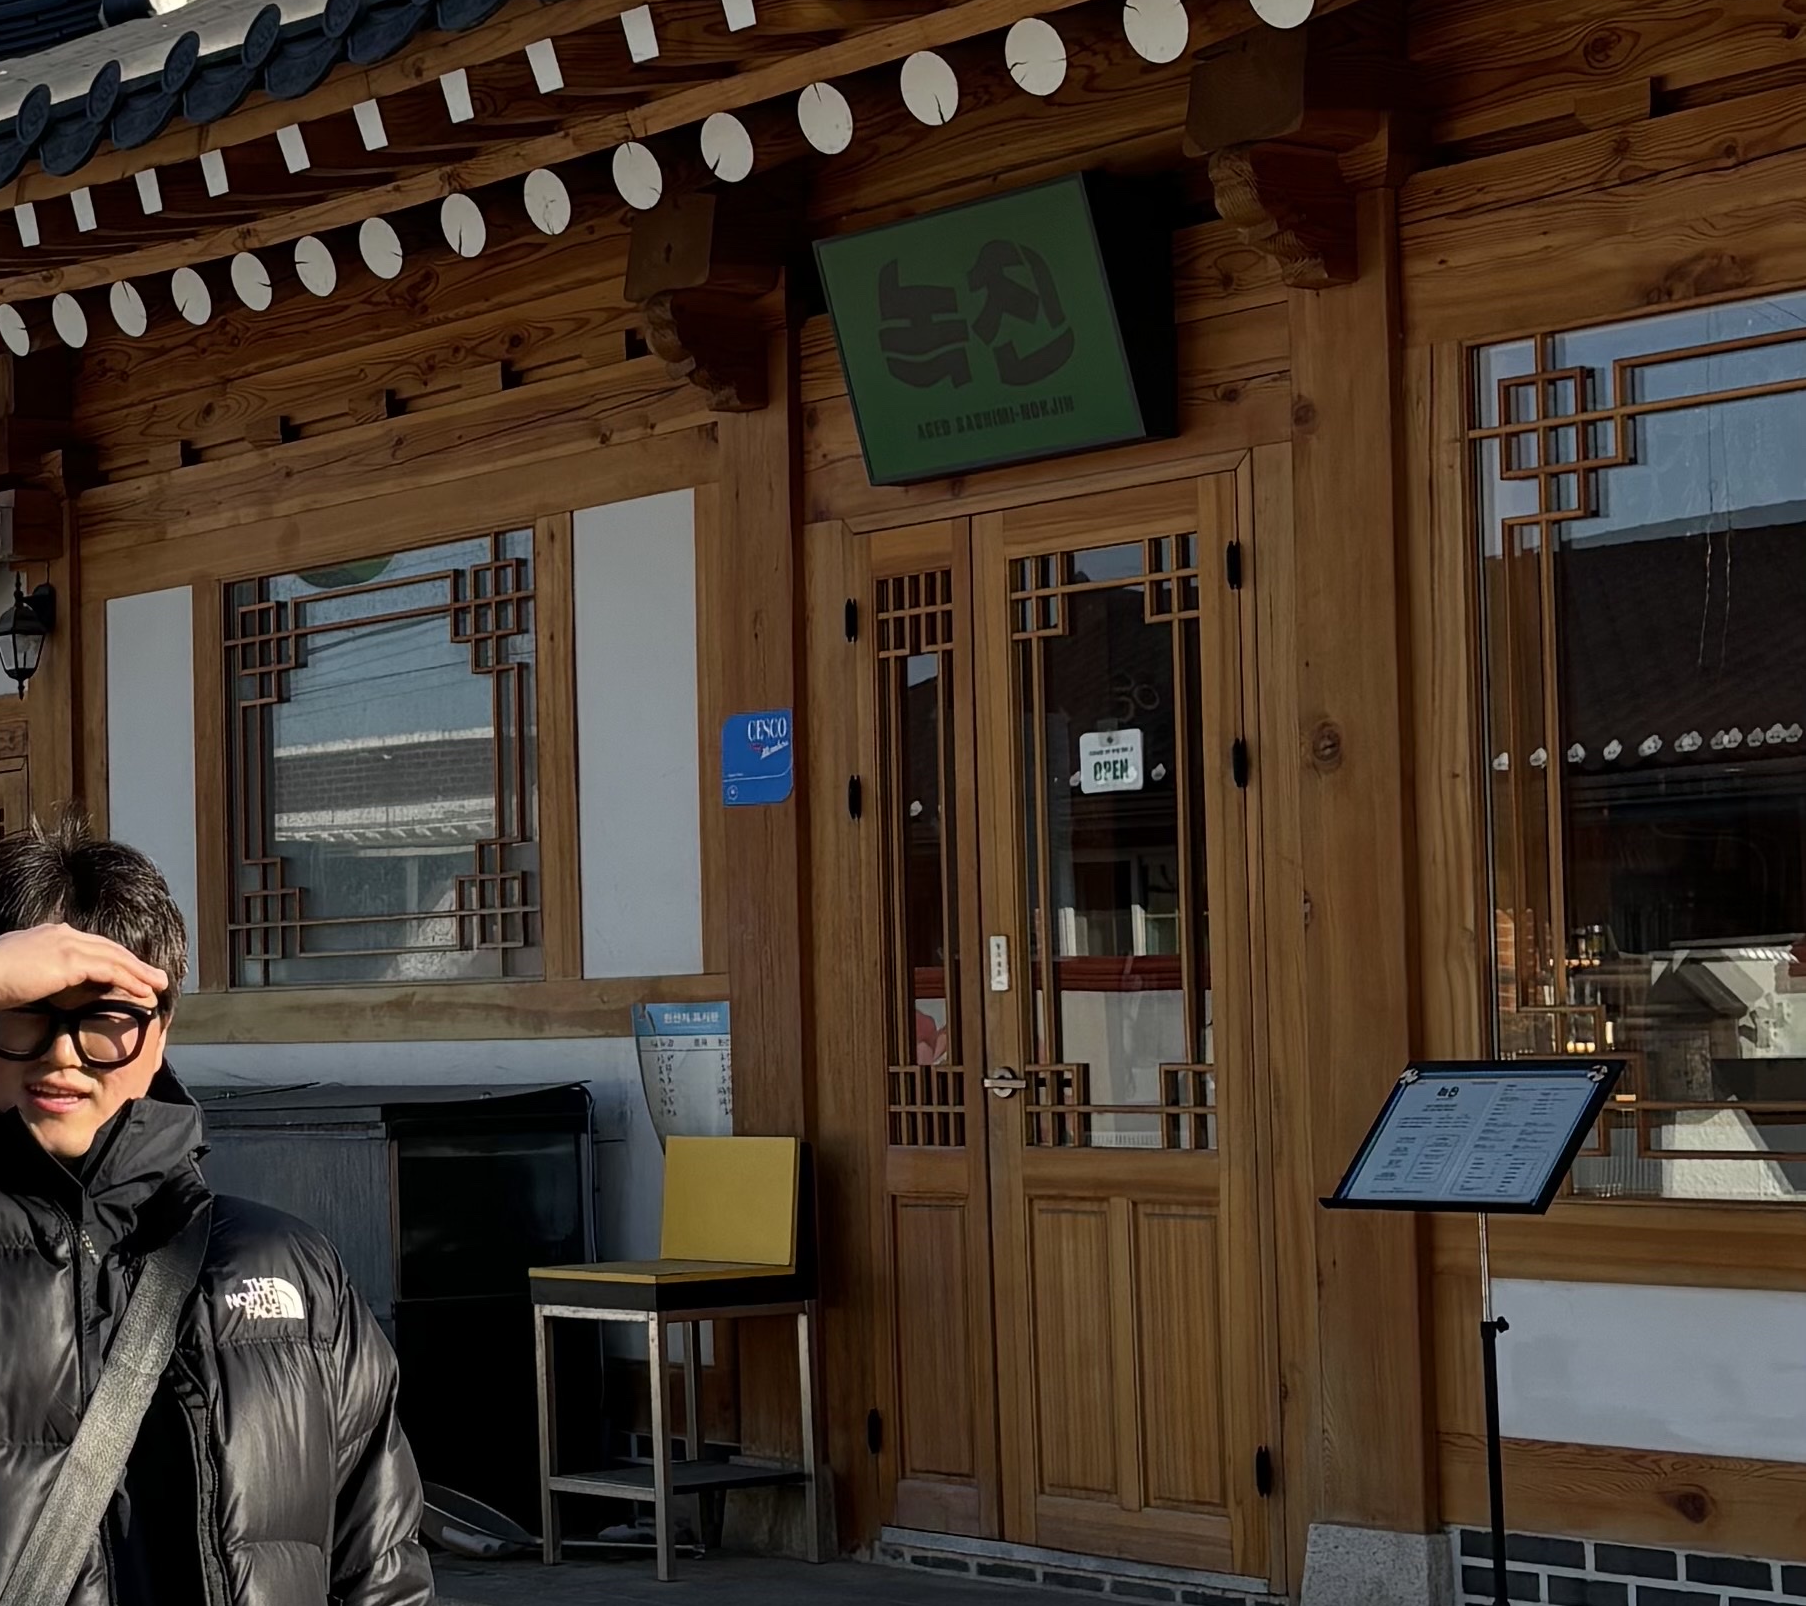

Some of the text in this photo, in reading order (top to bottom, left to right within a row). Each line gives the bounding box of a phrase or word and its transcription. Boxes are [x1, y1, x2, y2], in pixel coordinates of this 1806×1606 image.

[879, 239, 1075, 389] 녹진
[747, 716, 787, 742] CESCO
[1093, 758, 1129, 782] OPEN
[242, 1277, 274, 1292] THE
[225, 1288, 278, 1310] NORTH
[246, 1303, 282, 1320] FACE
